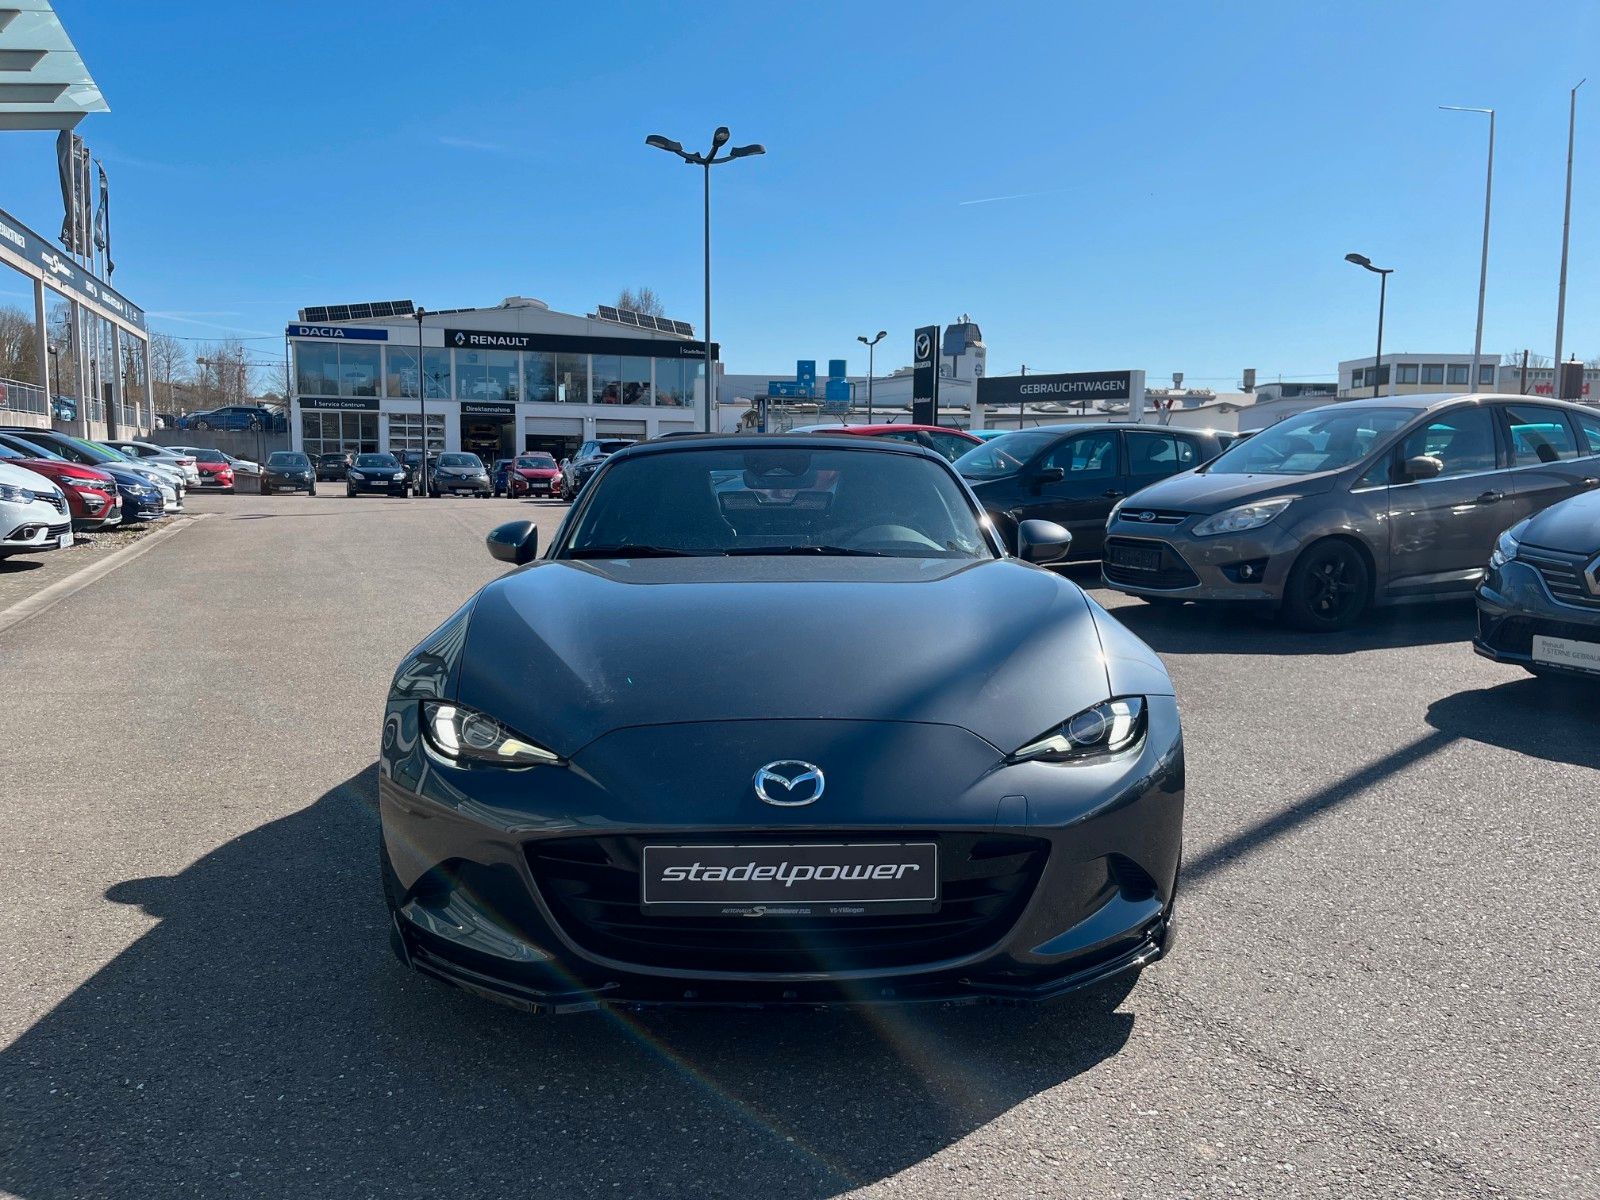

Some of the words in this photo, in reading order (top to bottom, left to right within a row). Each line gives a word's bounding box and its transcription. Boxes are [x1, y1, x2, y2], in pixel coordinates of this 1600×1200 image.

[299, 327, 345, 338] DACIA
[470, 335, 529, 347] RENAULT
[1020, 380, 1126, 394] GEBRAUCHTWAGEN
[341, 401, 366, 409] Centrum
[465, 405, 511, 413] Direktannahme
[661, 861, 920, 887] stadelpower
